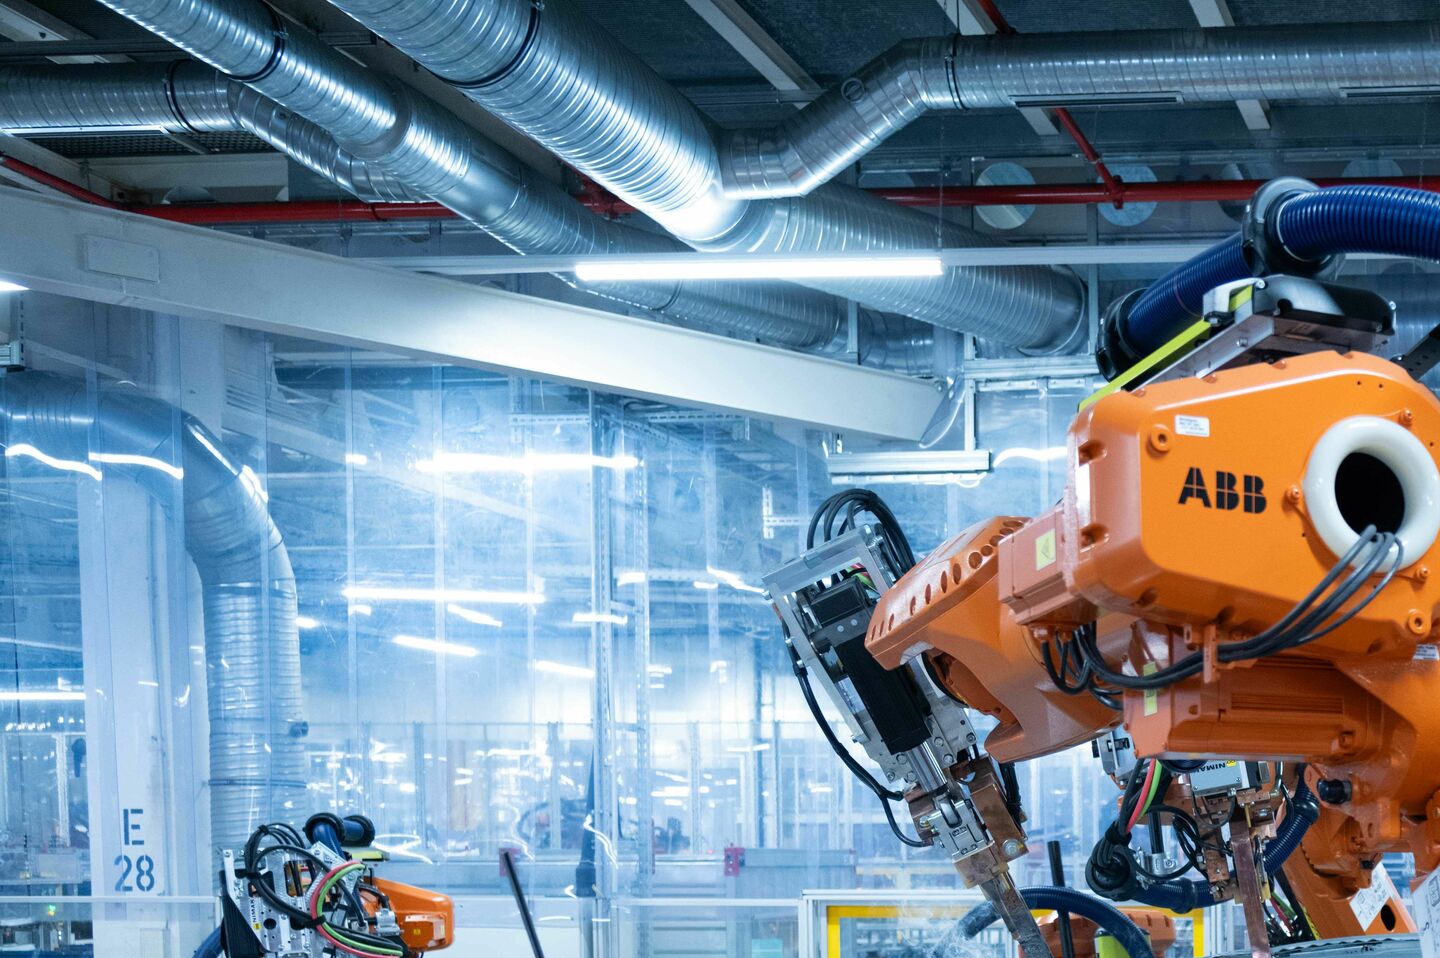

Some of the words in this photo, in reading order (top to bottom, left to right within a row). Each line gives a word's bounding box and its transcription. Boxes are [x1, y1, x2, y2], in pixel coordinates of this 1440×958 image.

[1178, 466, 1267, 514] ABB
[123, 808, 145, 846] E
[114, 854, 155, 892] 28
